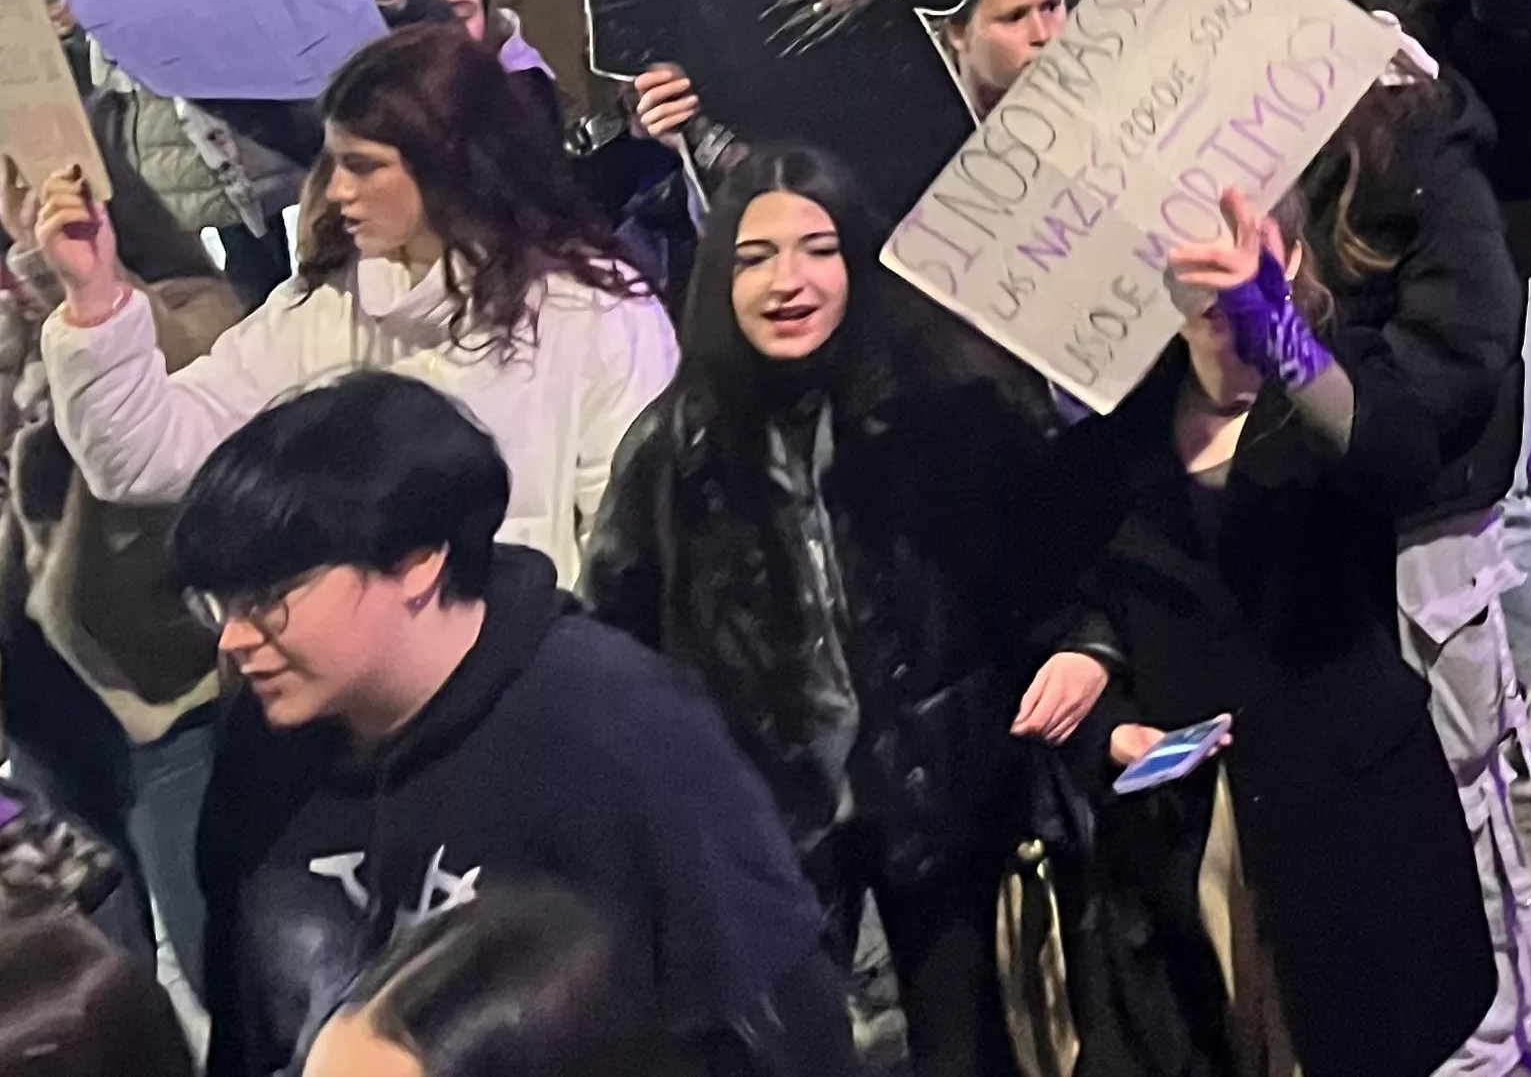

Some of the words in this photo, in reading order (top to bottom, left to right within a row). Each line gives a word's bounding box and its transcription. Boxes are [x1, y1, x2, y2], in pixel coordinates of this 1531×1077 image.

[934, 6, 1125, 240] NOSOTRAS
[891, 204, 984, 298] SI
[1015, 135, 1127, 273] NAZIS
